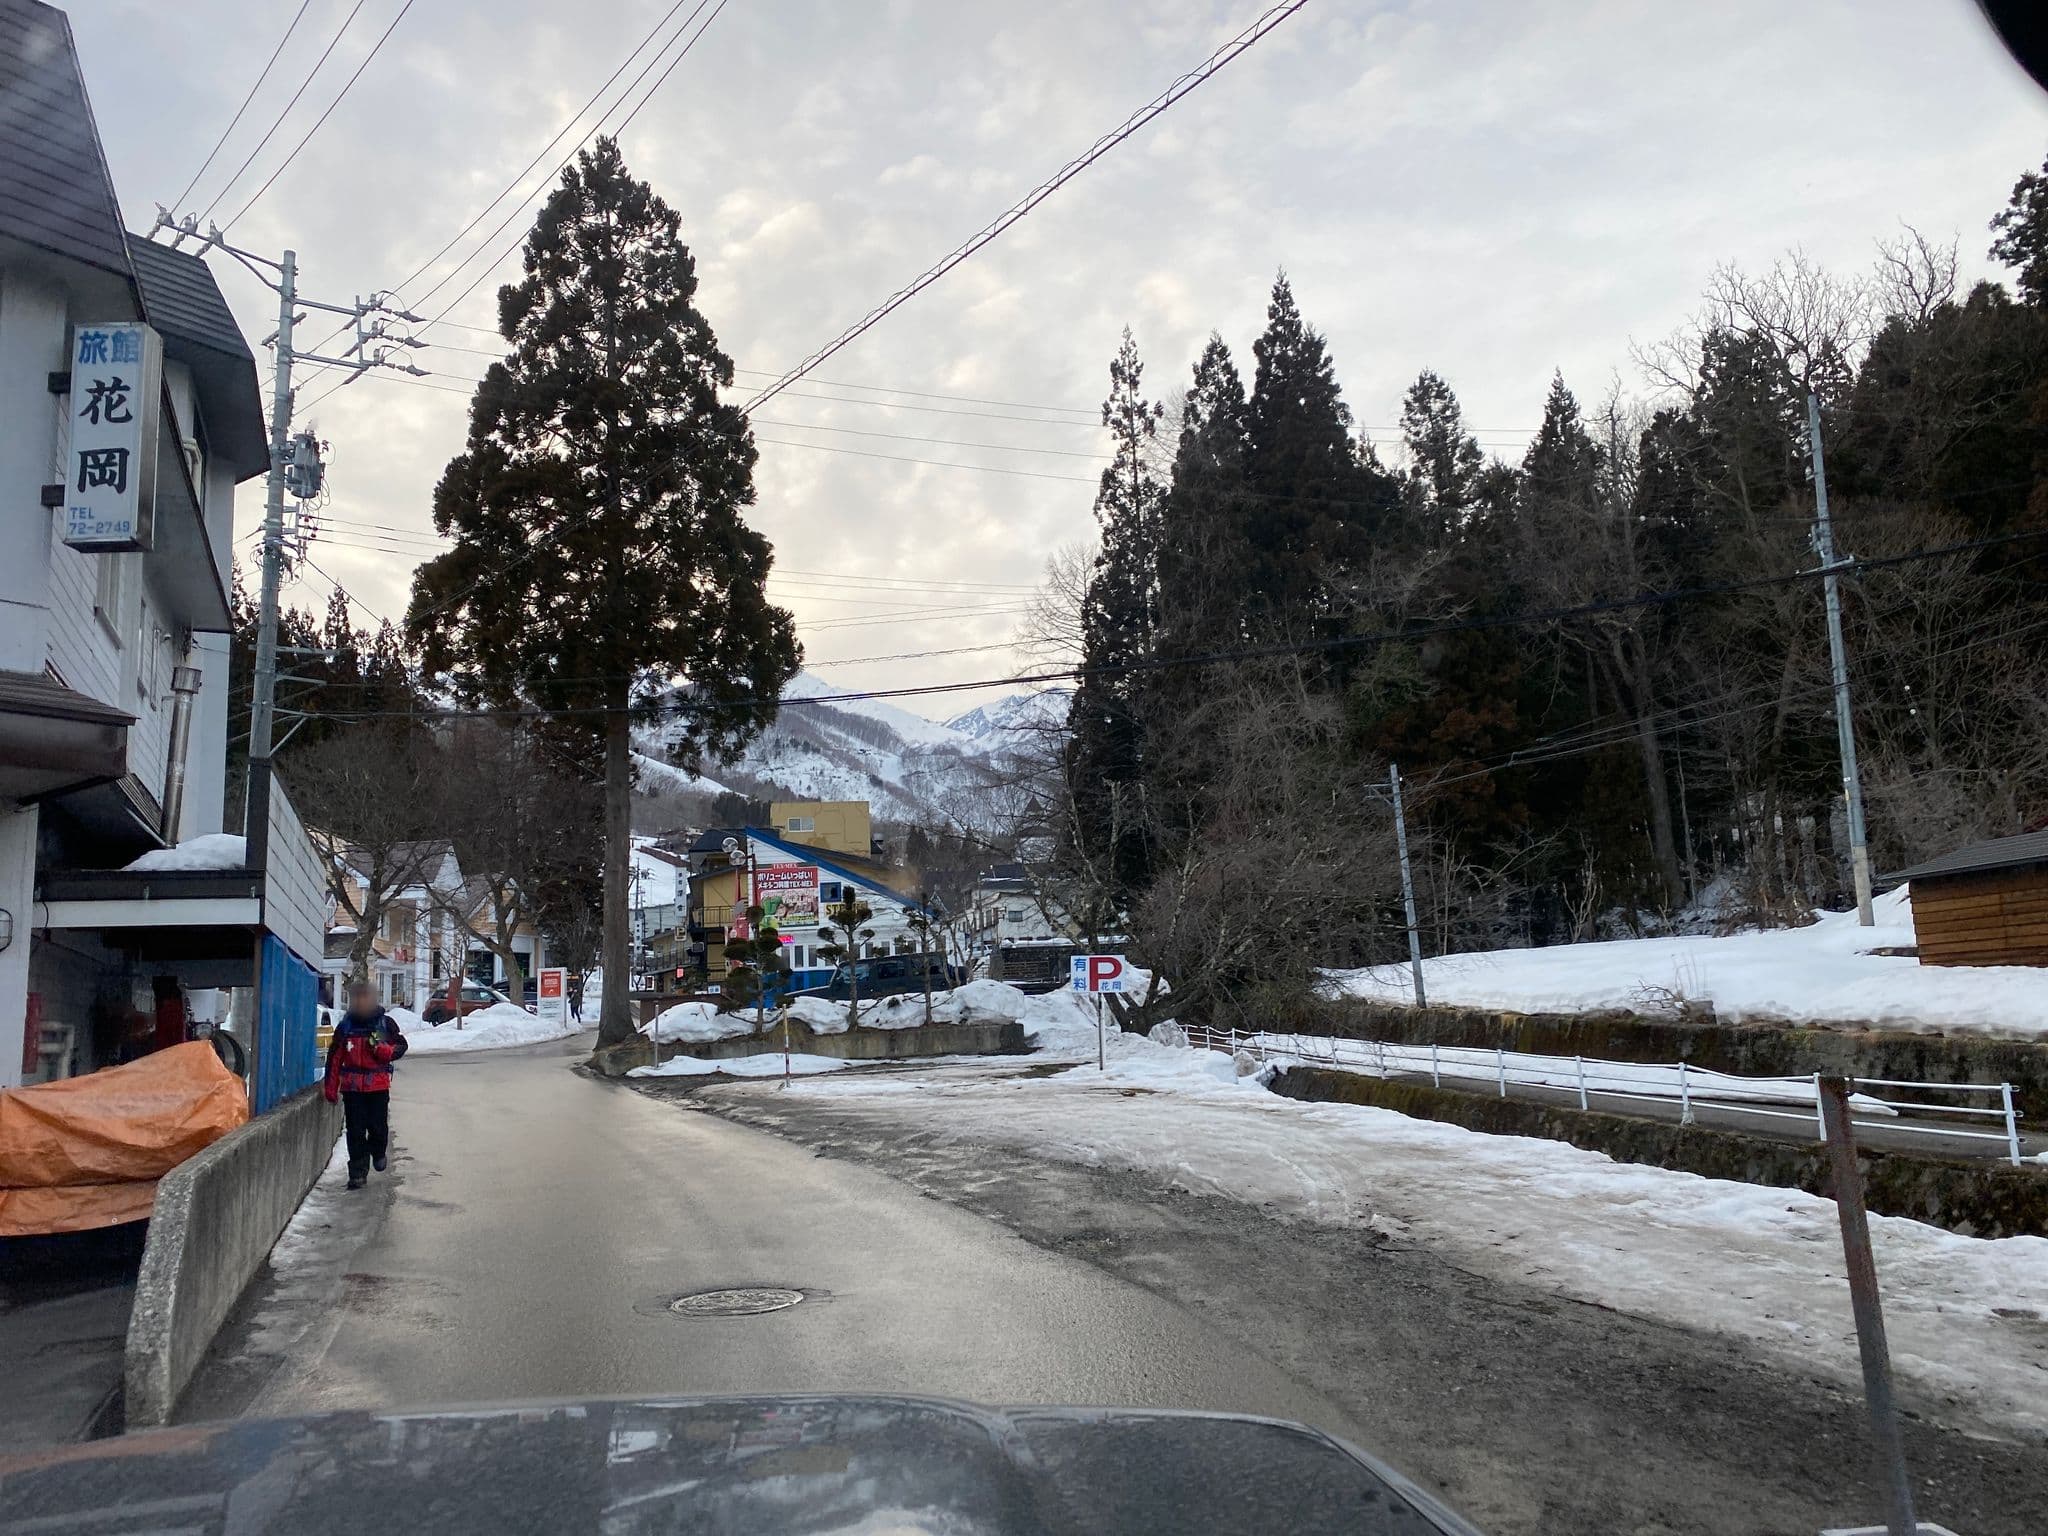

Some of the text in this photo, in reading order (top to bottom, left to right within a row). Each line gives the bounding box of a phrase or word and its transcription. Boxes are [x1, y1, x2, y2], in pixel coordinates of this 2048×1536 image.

[77, 329, 142, 364] 旅館
[76, 375, 134, 494] 花岡
[69, 507, 95, 520] TEL
[1073, 958, 1087, 991] 有料
[1088, 956, 1122, 992] P
